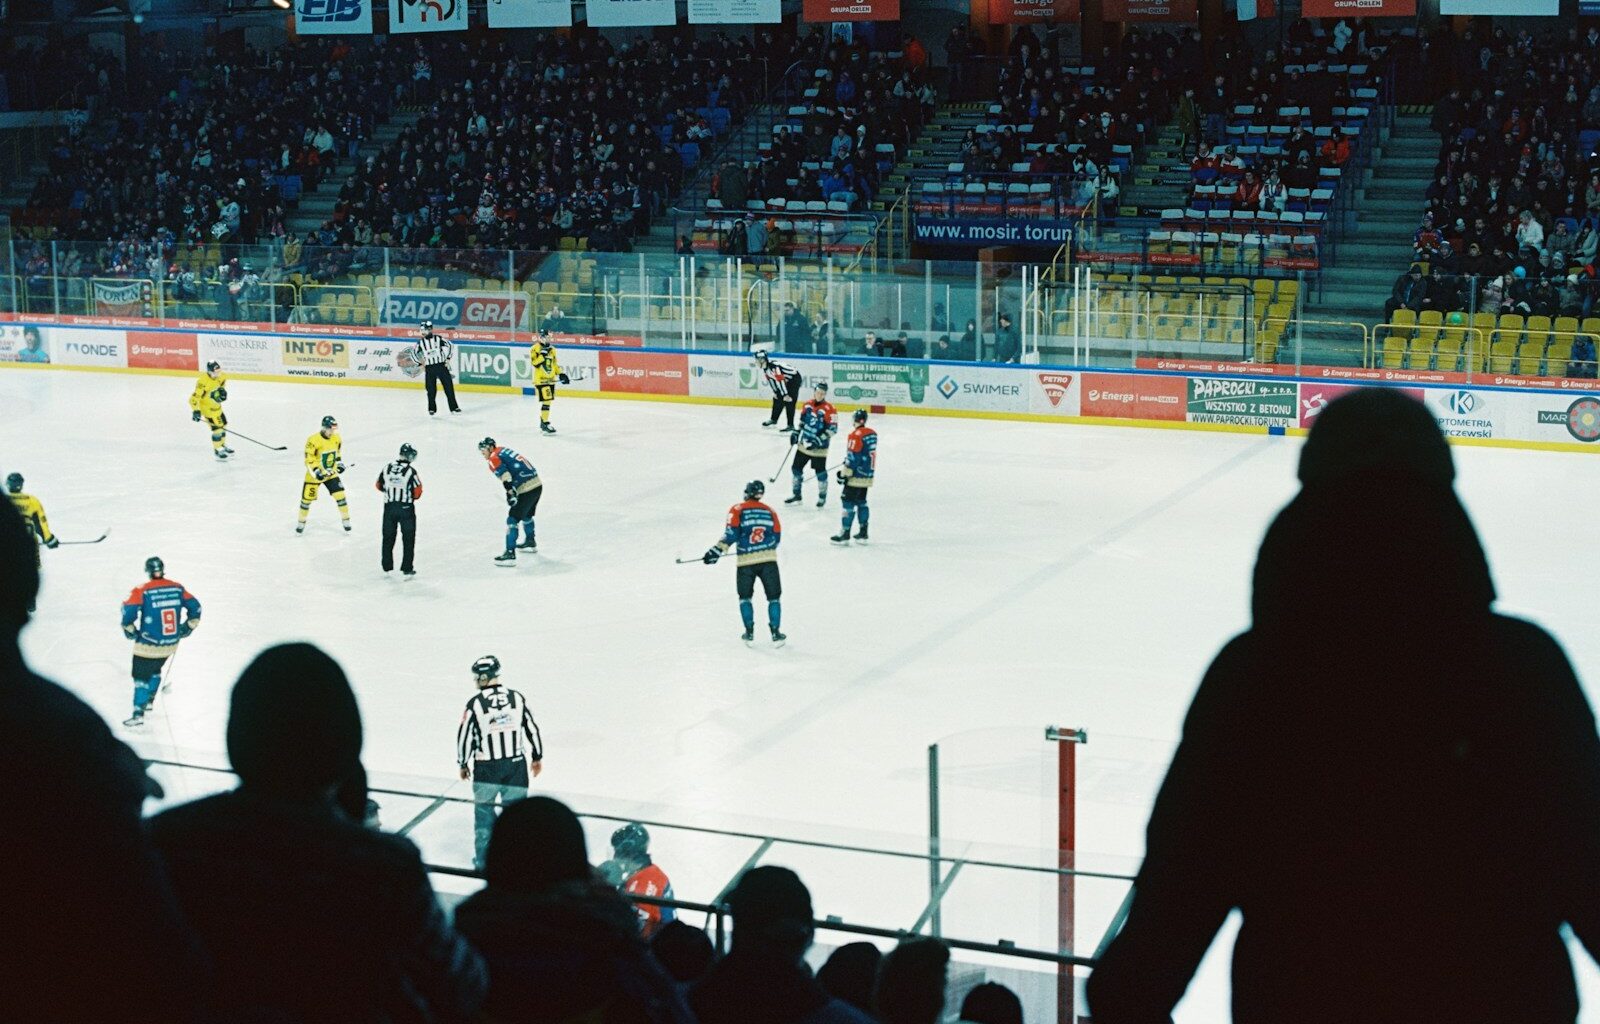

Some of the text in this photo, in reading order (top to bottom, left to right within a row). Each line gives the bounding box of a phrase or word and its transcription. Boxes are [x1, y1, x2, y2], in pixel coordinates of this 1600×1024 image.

[385, 300, 515, 323] RADIO GRA
[81, 344, 117, 356] ONDE
[285, 340, 344, 356] INTOP
[461, 352, 509, 374] MPO
[288, 368, 346, 378] www.intop.pl
[617, 367, 644, 378] Energa
[1043, 375, 1068, 384] PETRO
[1504, 377, 1526, 385] Energa
[1570, 381, 1592, 389] Energa
[964, 383, 1019, 396] SWIMER
[1193, 379, 1255, 399] PAPROCKI
[1102, 391, 1134, 403] Energa
[1205, 401, 1291, 415] WSZYSTKO Z BETONU
[1192, 414, 1290, 427] WWW.PAPROCKI.TORUN.PL
[1440, 429, 1492, 438] arczewski
[161, 608, 177, 636] 9
